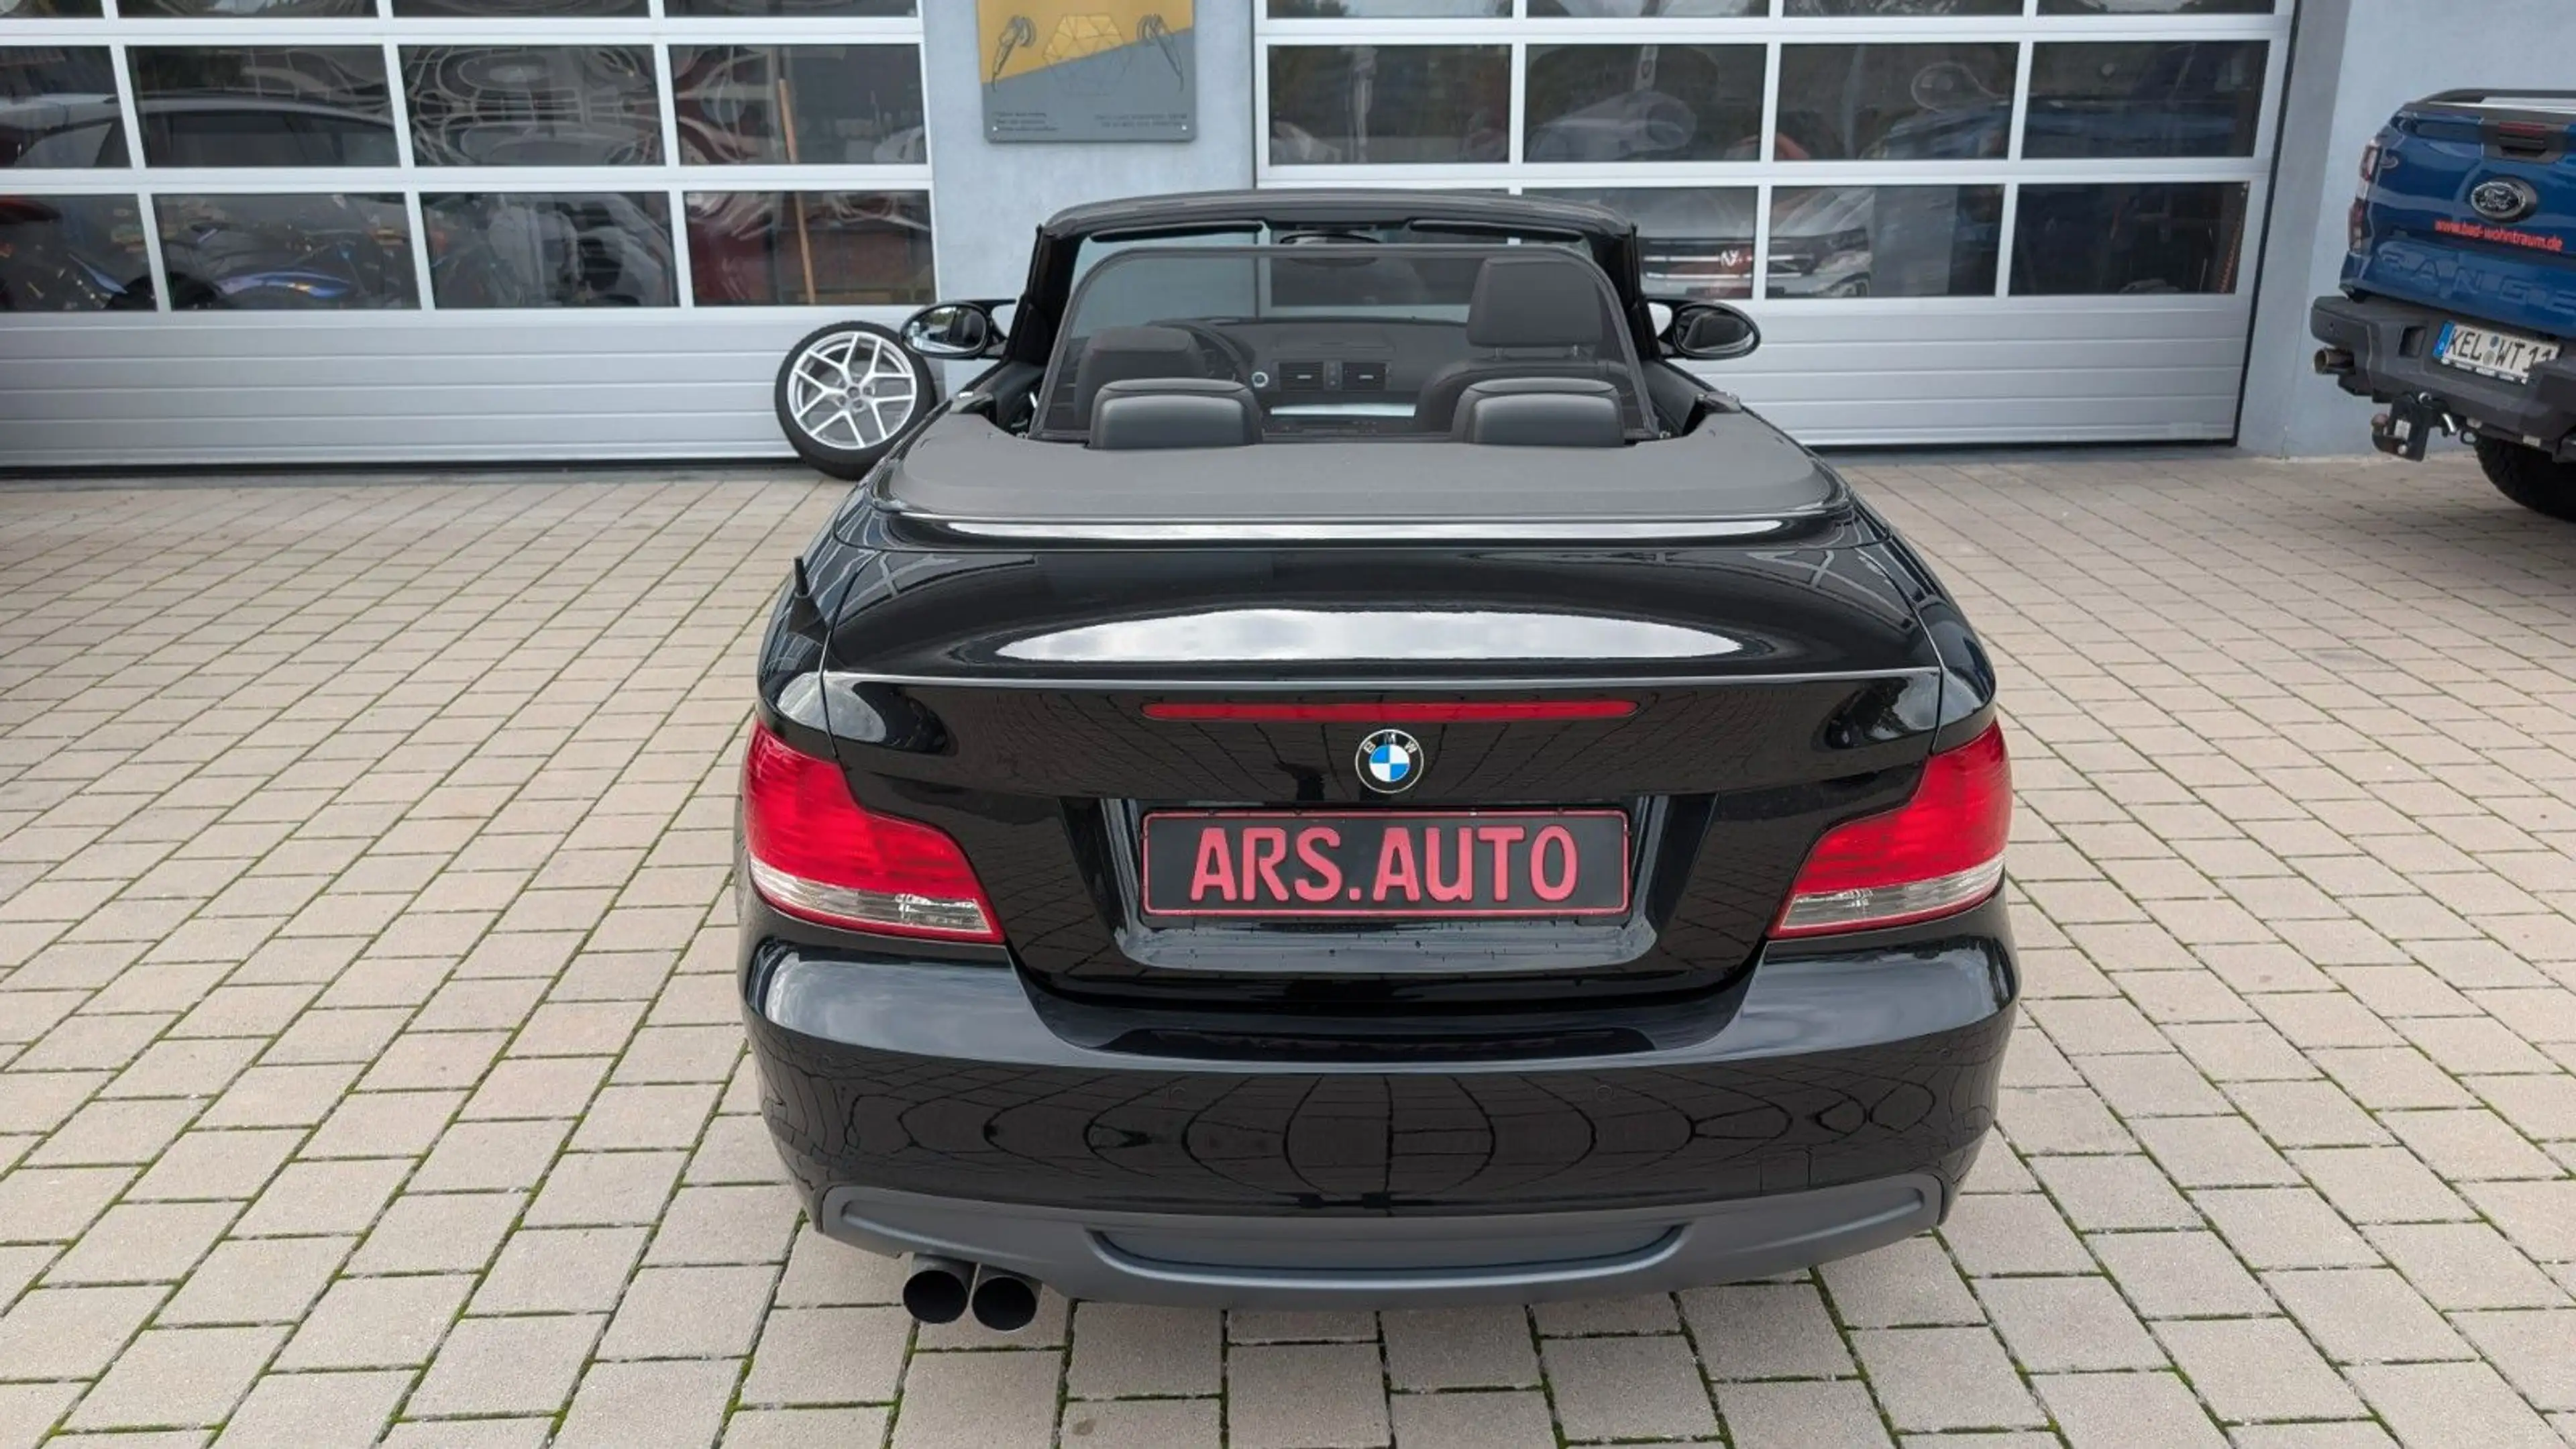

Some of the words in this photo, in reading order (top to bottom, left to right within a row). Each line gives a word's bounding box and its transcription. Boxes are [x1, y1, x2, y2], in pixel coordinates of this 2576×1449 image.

[2446, 329, 2482, 361] KEL
[2495, 339, 2526, 369] WT
[1363, 732, 1419, 754] BMW
[1190, 825, 1578, 902] ARS.AUTO
